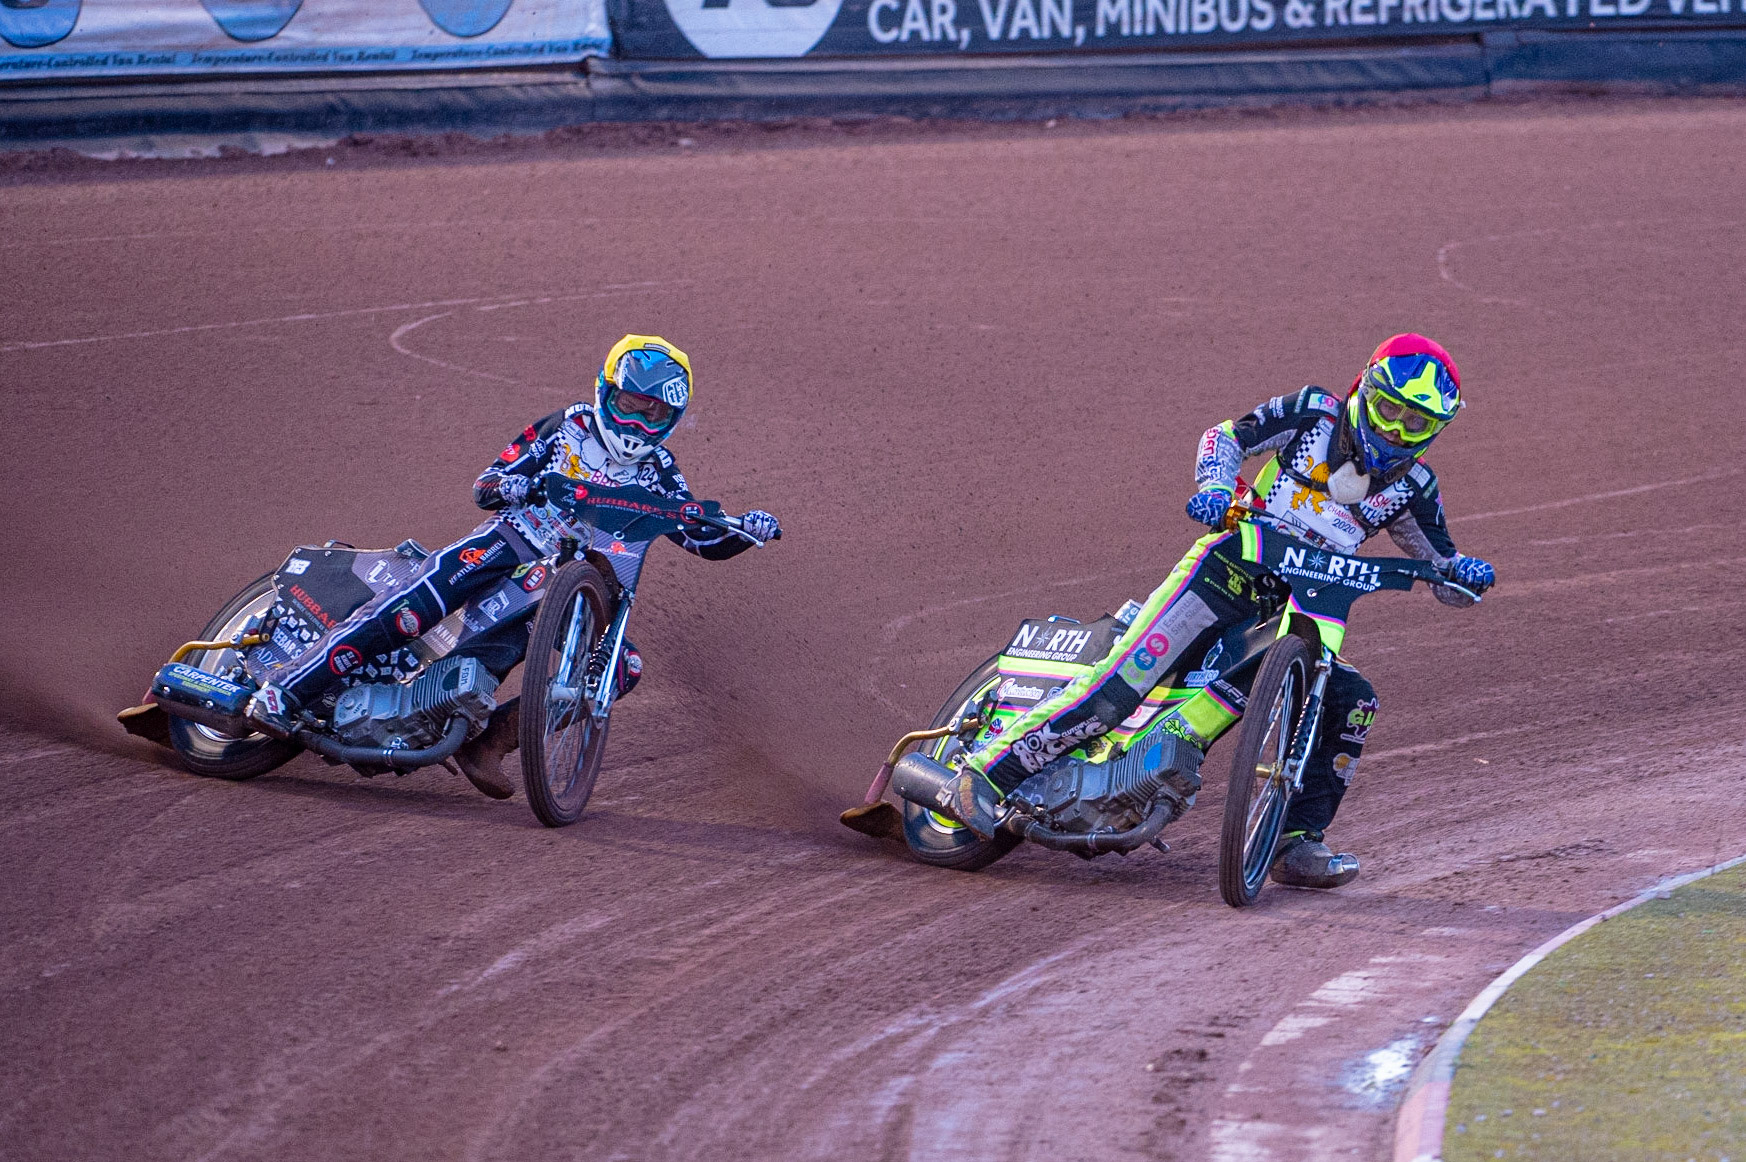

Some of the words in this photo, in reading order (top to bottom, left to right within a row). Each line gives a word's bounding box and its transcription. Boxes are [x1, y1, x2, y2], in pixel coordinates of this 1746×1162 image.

[867, 0, 971, 50] CAR,
[980, 0, 1087, 46] VAN,
[1095, 0, 1276, 37] MINIBUS
[1283, 0, 1315, 28] &
[1332, 517, 1356, 536] 2020
[1281, 566, 1341, 583] ENGINEERING
[1342, 578, 1376, 593] GROUP
[1283, 547, 1381, 584] NRTH
[1012, 624, 1092, 654] NRTH
[1006, 646, 1054, 661] ENGINEERING
[1050, 651, 1078, 662] GROUP
[173, 665, 241, 693] CARPENTER
